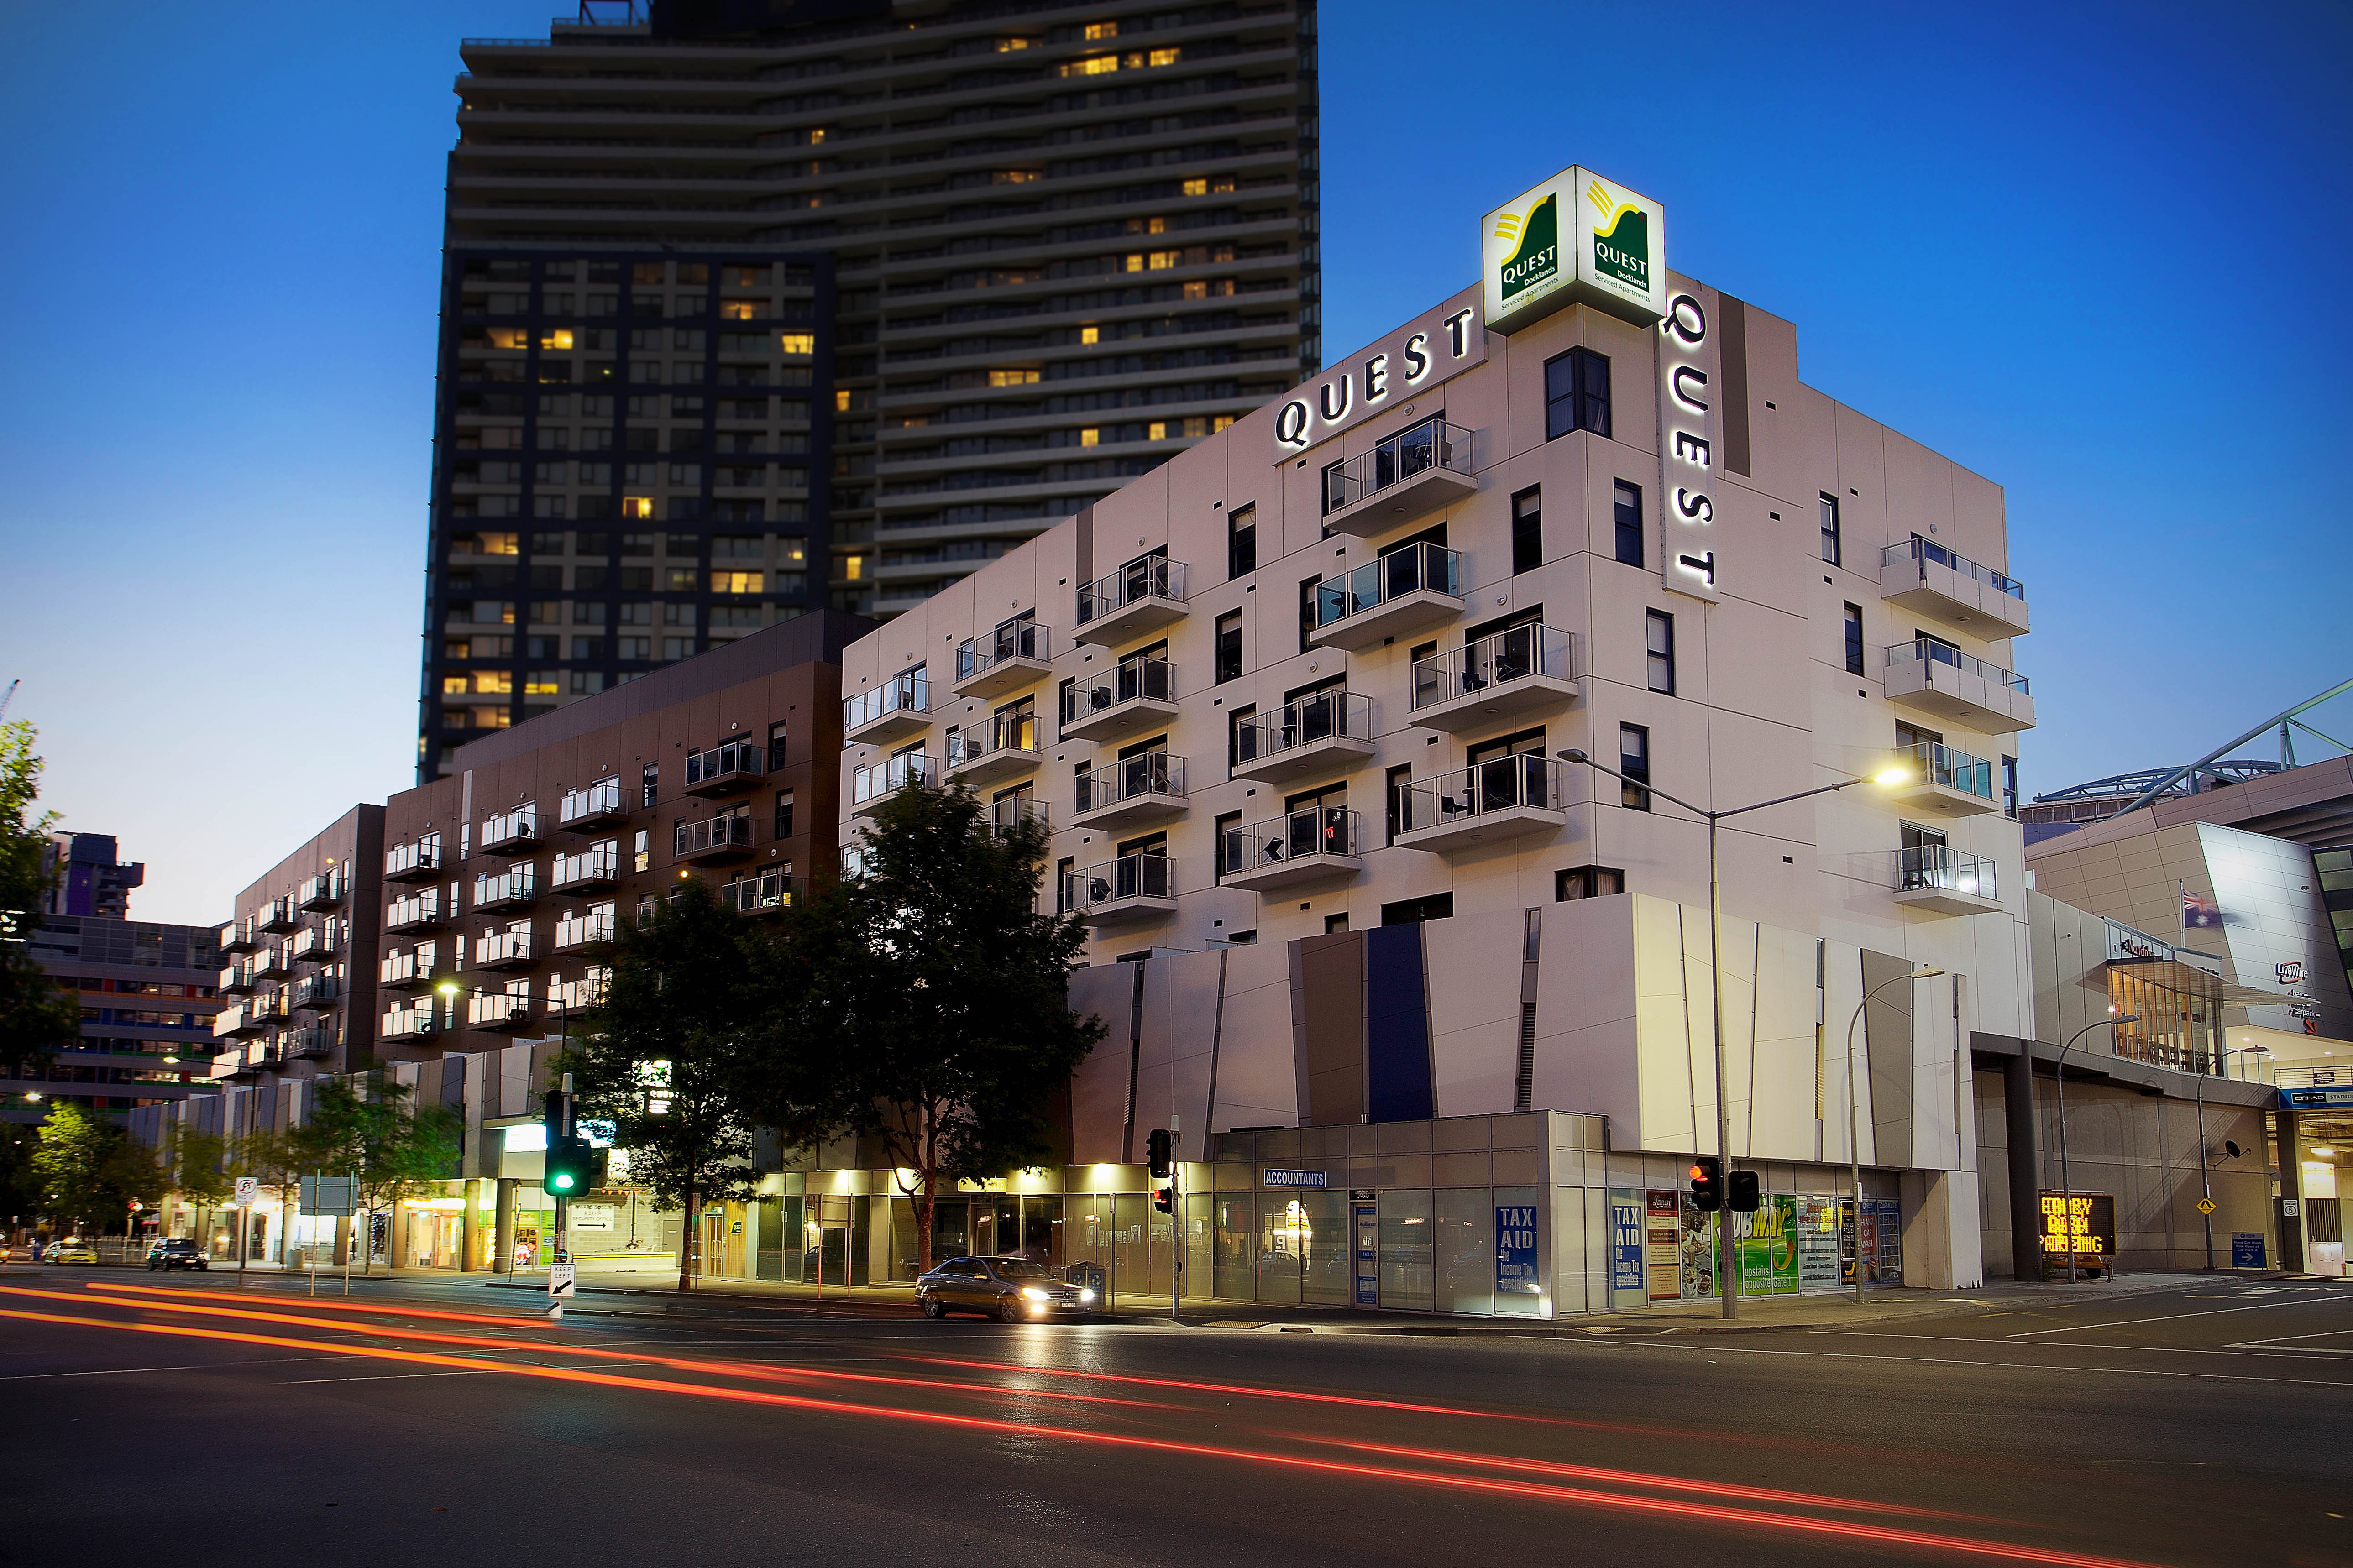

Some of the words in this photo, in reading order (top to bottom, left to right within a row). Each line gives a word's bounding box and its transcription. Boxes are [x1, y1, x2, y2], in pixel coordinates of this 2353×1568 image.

[1504, 245, 1556, 284] QUEST
[1597, 242, 1646, 276] QUEST
[1525, 266, 1556, 286] Docklands
[1618, 270, 1647, 288] Docklands
[1501, 293, 1525, 310] Serviced
[1525, 277, 1559, 298] Apartments
[1594, 273, 1618, 288] Serviced
[1619, 284, 1651, 302] Apartments
[1276, 309, 1471, 447] QUEST
[1663, 294, 1715, 585] QUEST
[2276, 962, 2308, 978] LiveWire
[2294, 1008, 2315, 1017] carpark
[1266, 1171, 1323, 1185] ACCOUNTANTS
[1500, 1209, 1532, 1226] TAX
[1615, 1207, 1639, 1225] TAX
[1715, 1202, 1792, 1238] UBWAY
[1501, 1230, 1533, 1248] AID
[1615, 1228, 1639, 1246] AID
[1500, 1249, 1510, 1262] the
[1500, 1262, 1522, 1276] Income
[1523, 1263, 1534, 1276] Tax
[1616, 1260, 1631, 1273] Income
[1631, 1260, 1640, 1272] Tax
[1745, 1265, 1769, 1279] upstairs
[1616, 1273, 1639, 1288] specialists
[1745, 1278, 1771, 1292] opposite
[1773, 1276, 1787, 1288] Gate
[1788, 1276, 1792, 1287] 1
